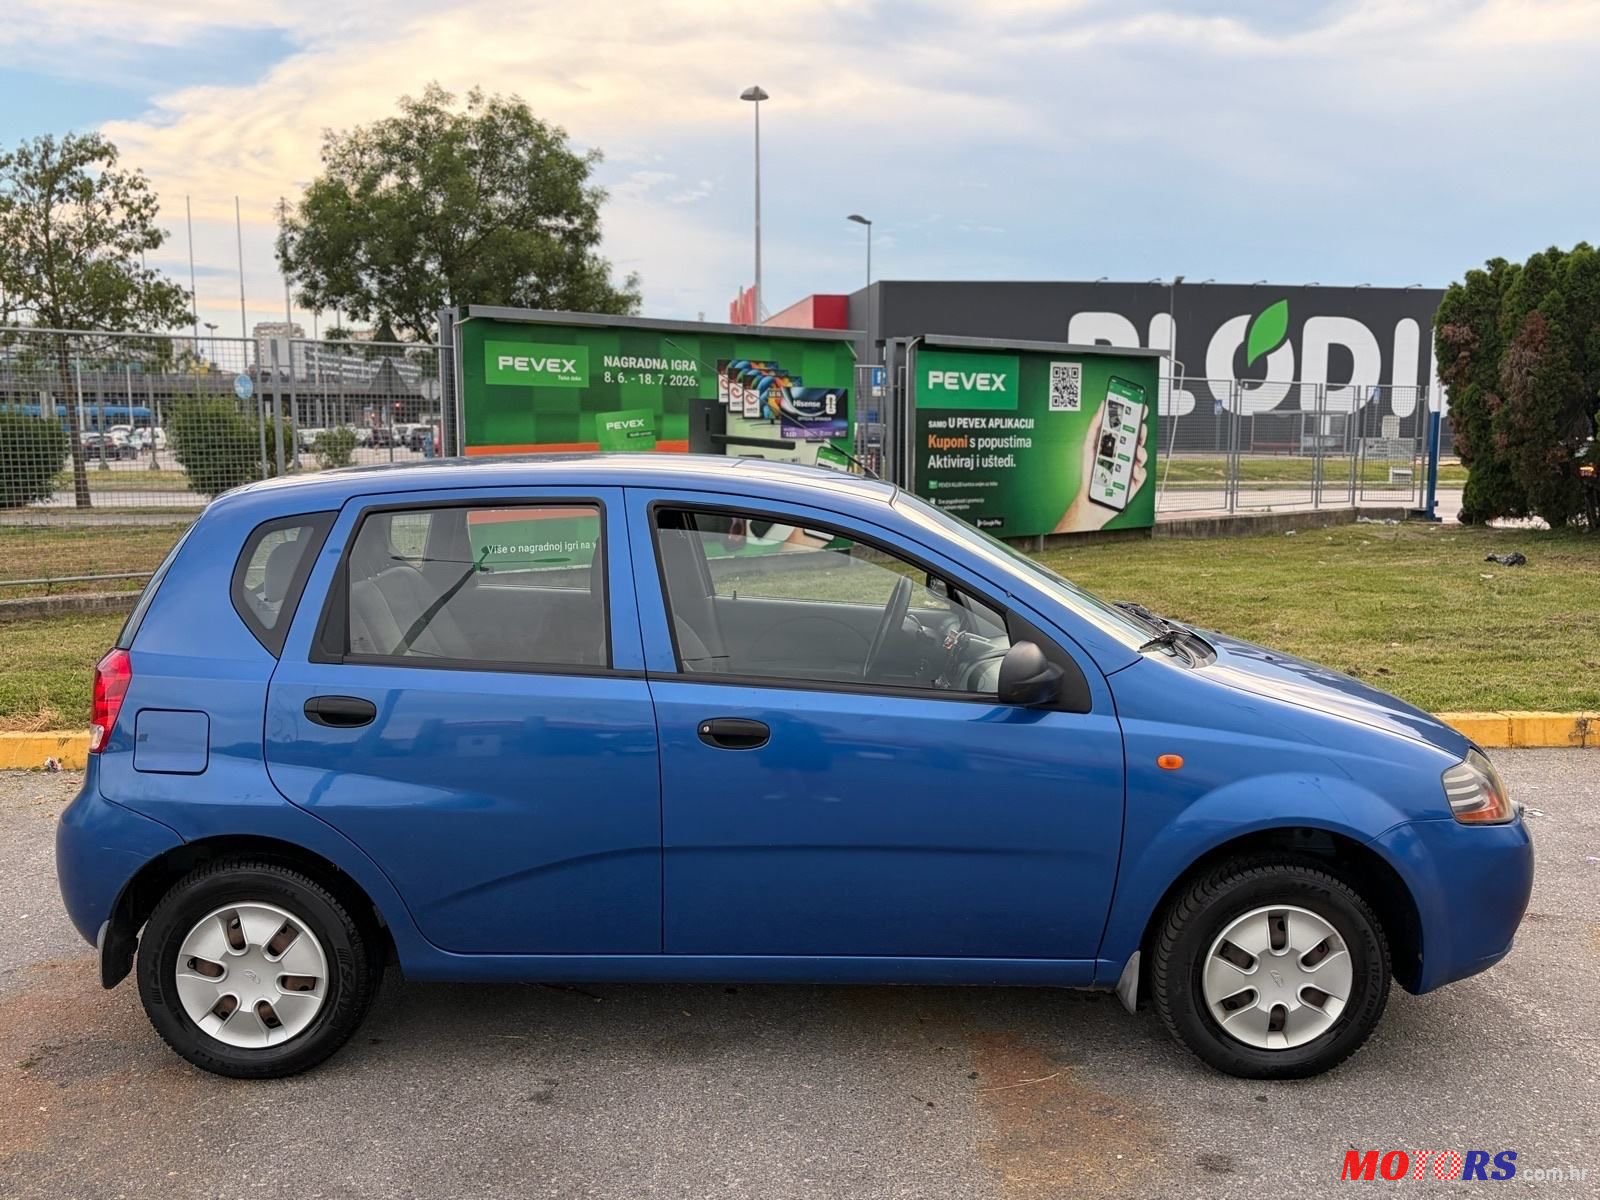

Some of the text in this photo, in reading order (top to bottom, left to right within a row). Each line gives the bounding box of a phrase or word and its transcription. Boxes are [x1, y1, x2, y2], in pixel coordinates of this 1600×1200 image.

[498, 355, 577, 374] PEVEX
[604, 355, 697, 372] NAGRADNA IGRA
[604, 372, 615, 384] 8.
[618, 373, 628, 384] 6.
[639, 373, 655, 385] 18.
[658, 374, 667, 385] 7.
[669, 374, 699, 387] 2026.
[928, 371, 1006, 391] PEVEX
[793, 400, 821, 408] Hisense
[606, 418, 645, 431] PEVEX
[948, 417, 955, 428] U
[957, 417, 986, 428] PEVEX
[988, 418, 1034, 429] APLIKACIJI
[928, 434, 1032, 450] Kuponi s popustima
[928, 454, 974, 470] Aktiviraj
[981, 454, 1017, 468] uštedi.
[487, 544, 508, 554] Više
[518, 541, 562, 554] nagradnoj
[565, 540, 579, 551] igri
